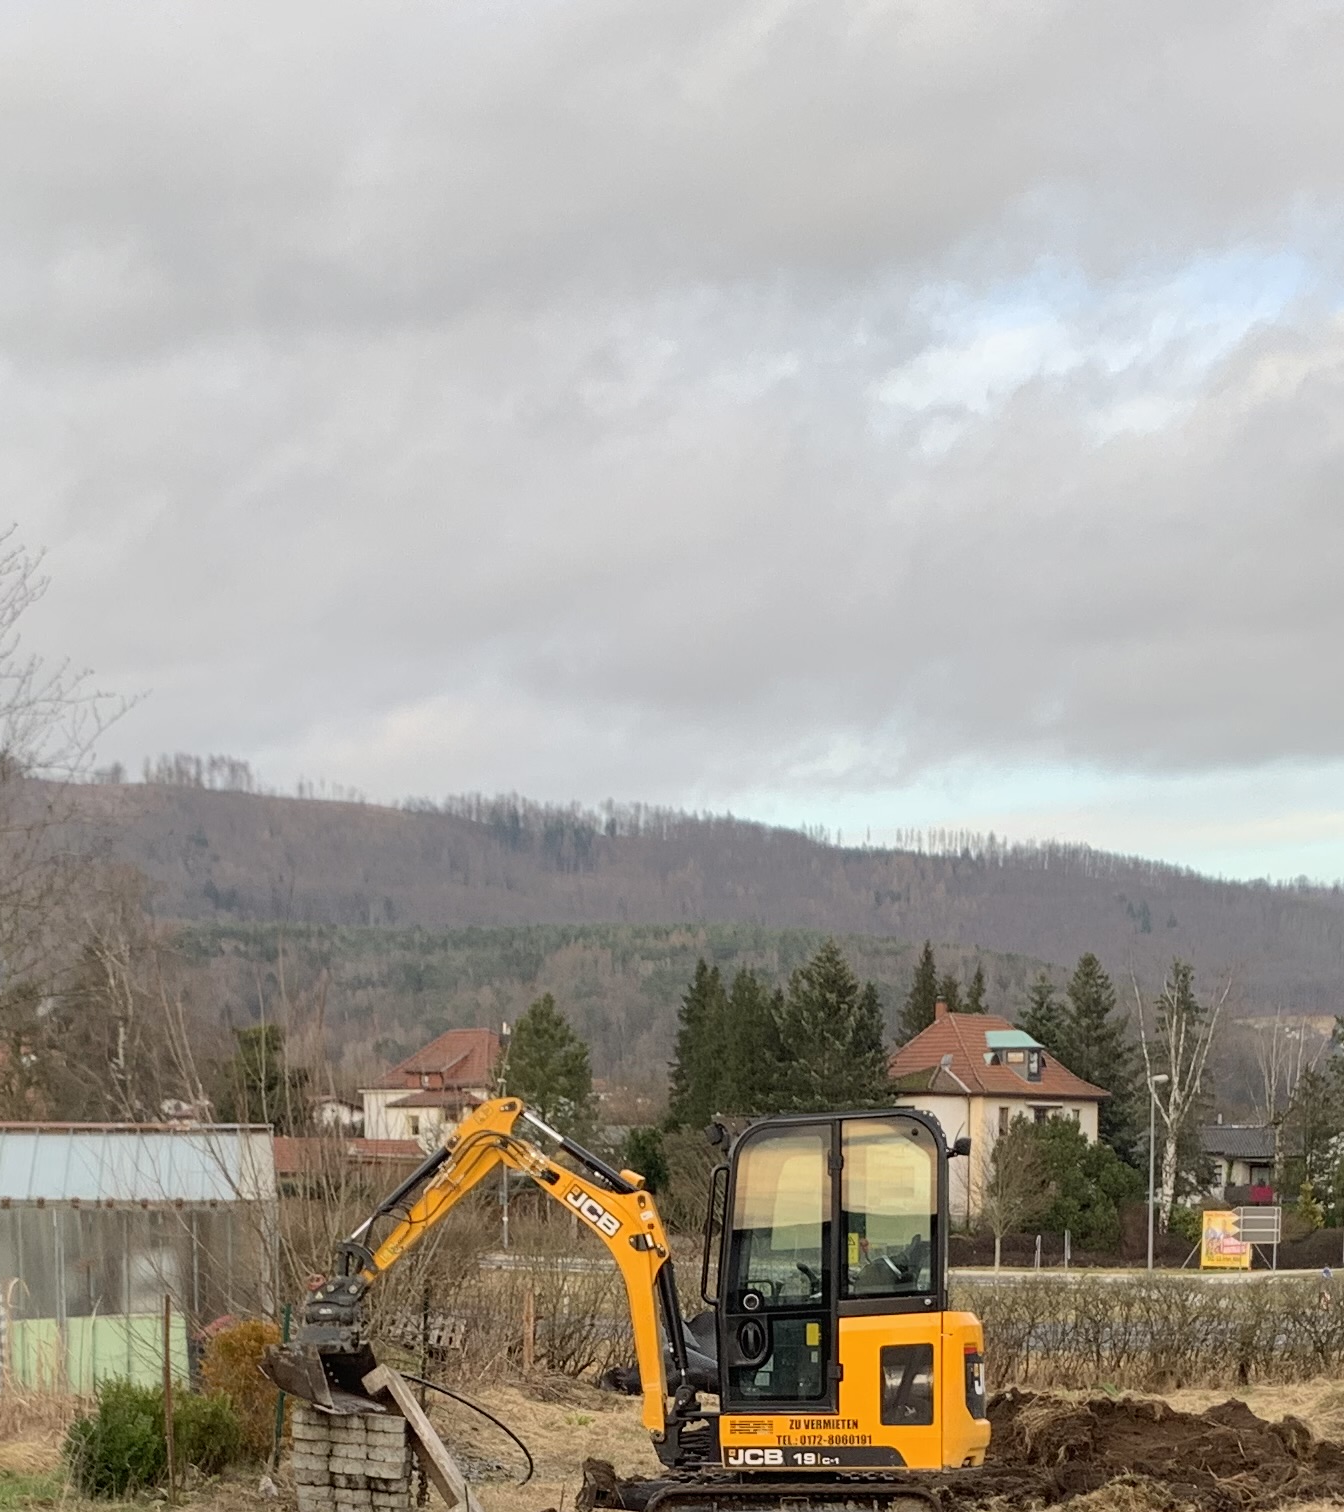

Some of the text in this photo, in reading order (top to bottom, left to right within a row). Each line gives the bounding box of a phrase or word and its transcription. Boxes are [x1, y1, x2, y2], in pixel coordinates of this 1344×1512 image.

[566, 1185, 621, 1237] JCB
[789, 1419, 858, 1430] ZU VERMIETEN
[800, 1434, 872, 1446] 0172-8060191
[728, 1448, 783, 1465] JCB
